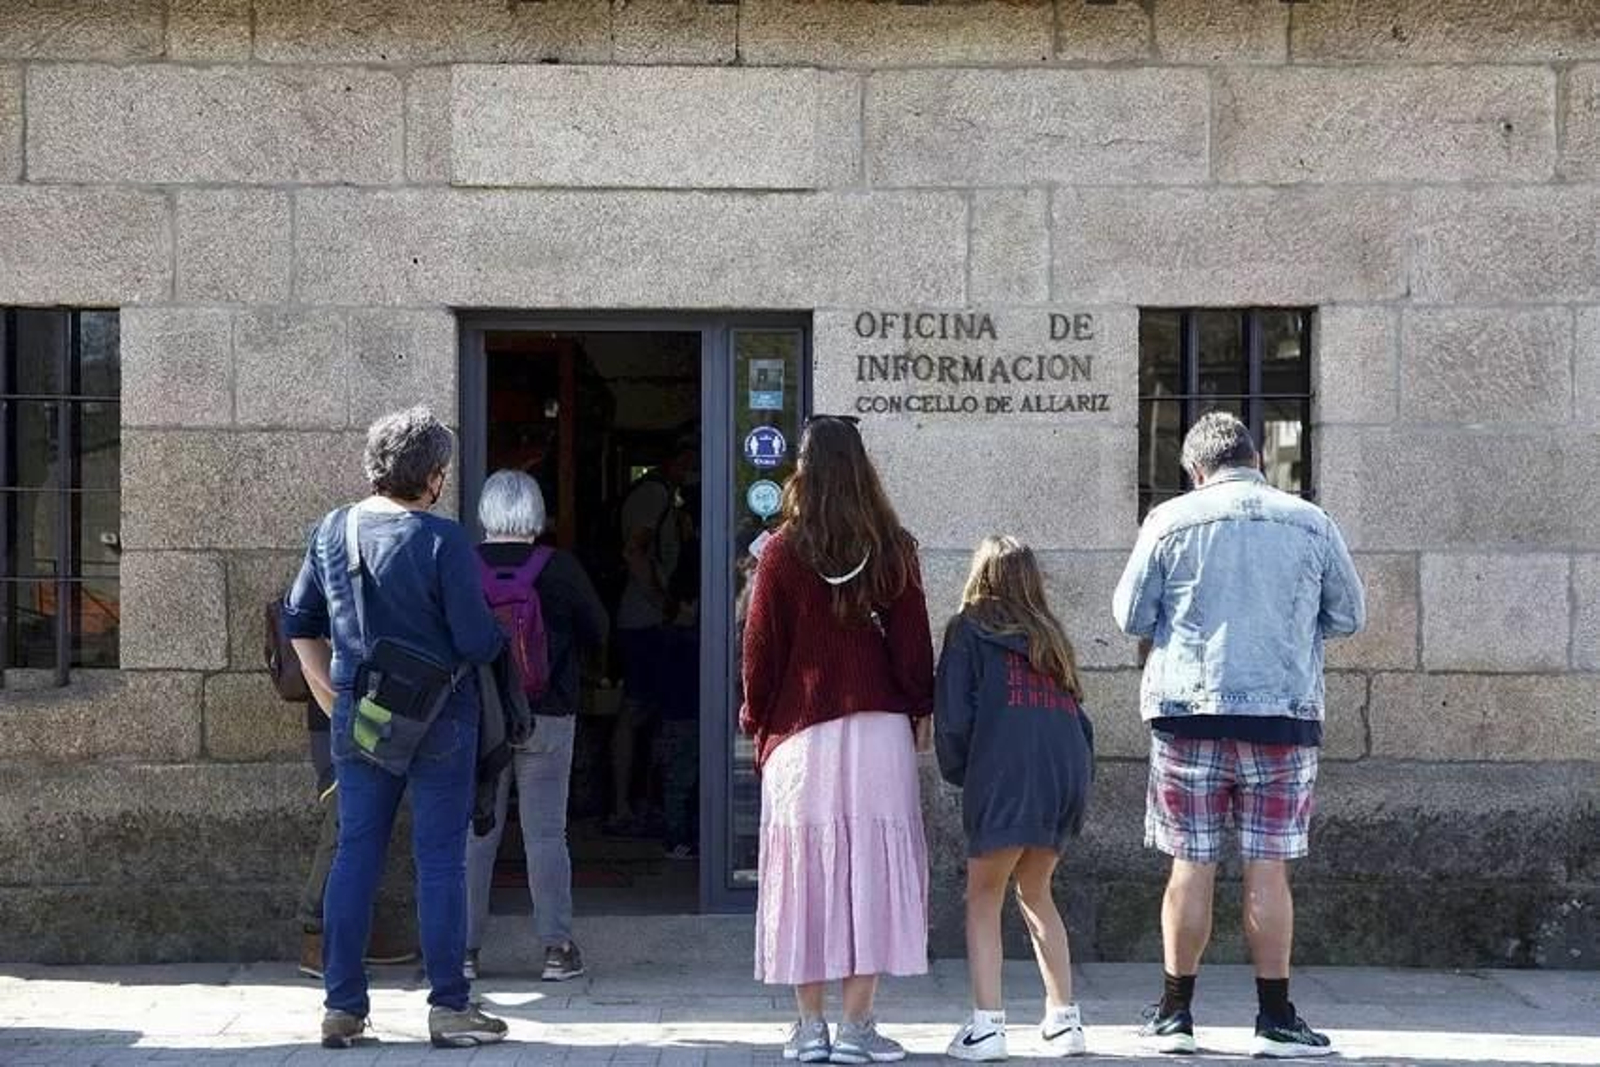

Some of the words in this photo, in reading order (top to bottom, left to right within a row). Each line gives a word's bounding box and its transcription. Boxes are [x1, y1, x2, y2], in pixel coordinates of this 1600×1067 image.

[855, 311, 998, 340] OFICINA
[1048, 312, 1094, 341] DE
[856, 354, 1094, 384] INFORMACION
[856, 395, 979, 414] CONCELLO
[985, 396, 1013, 414] DE
[1019, 394, 1111, 414] ALLARIZ
